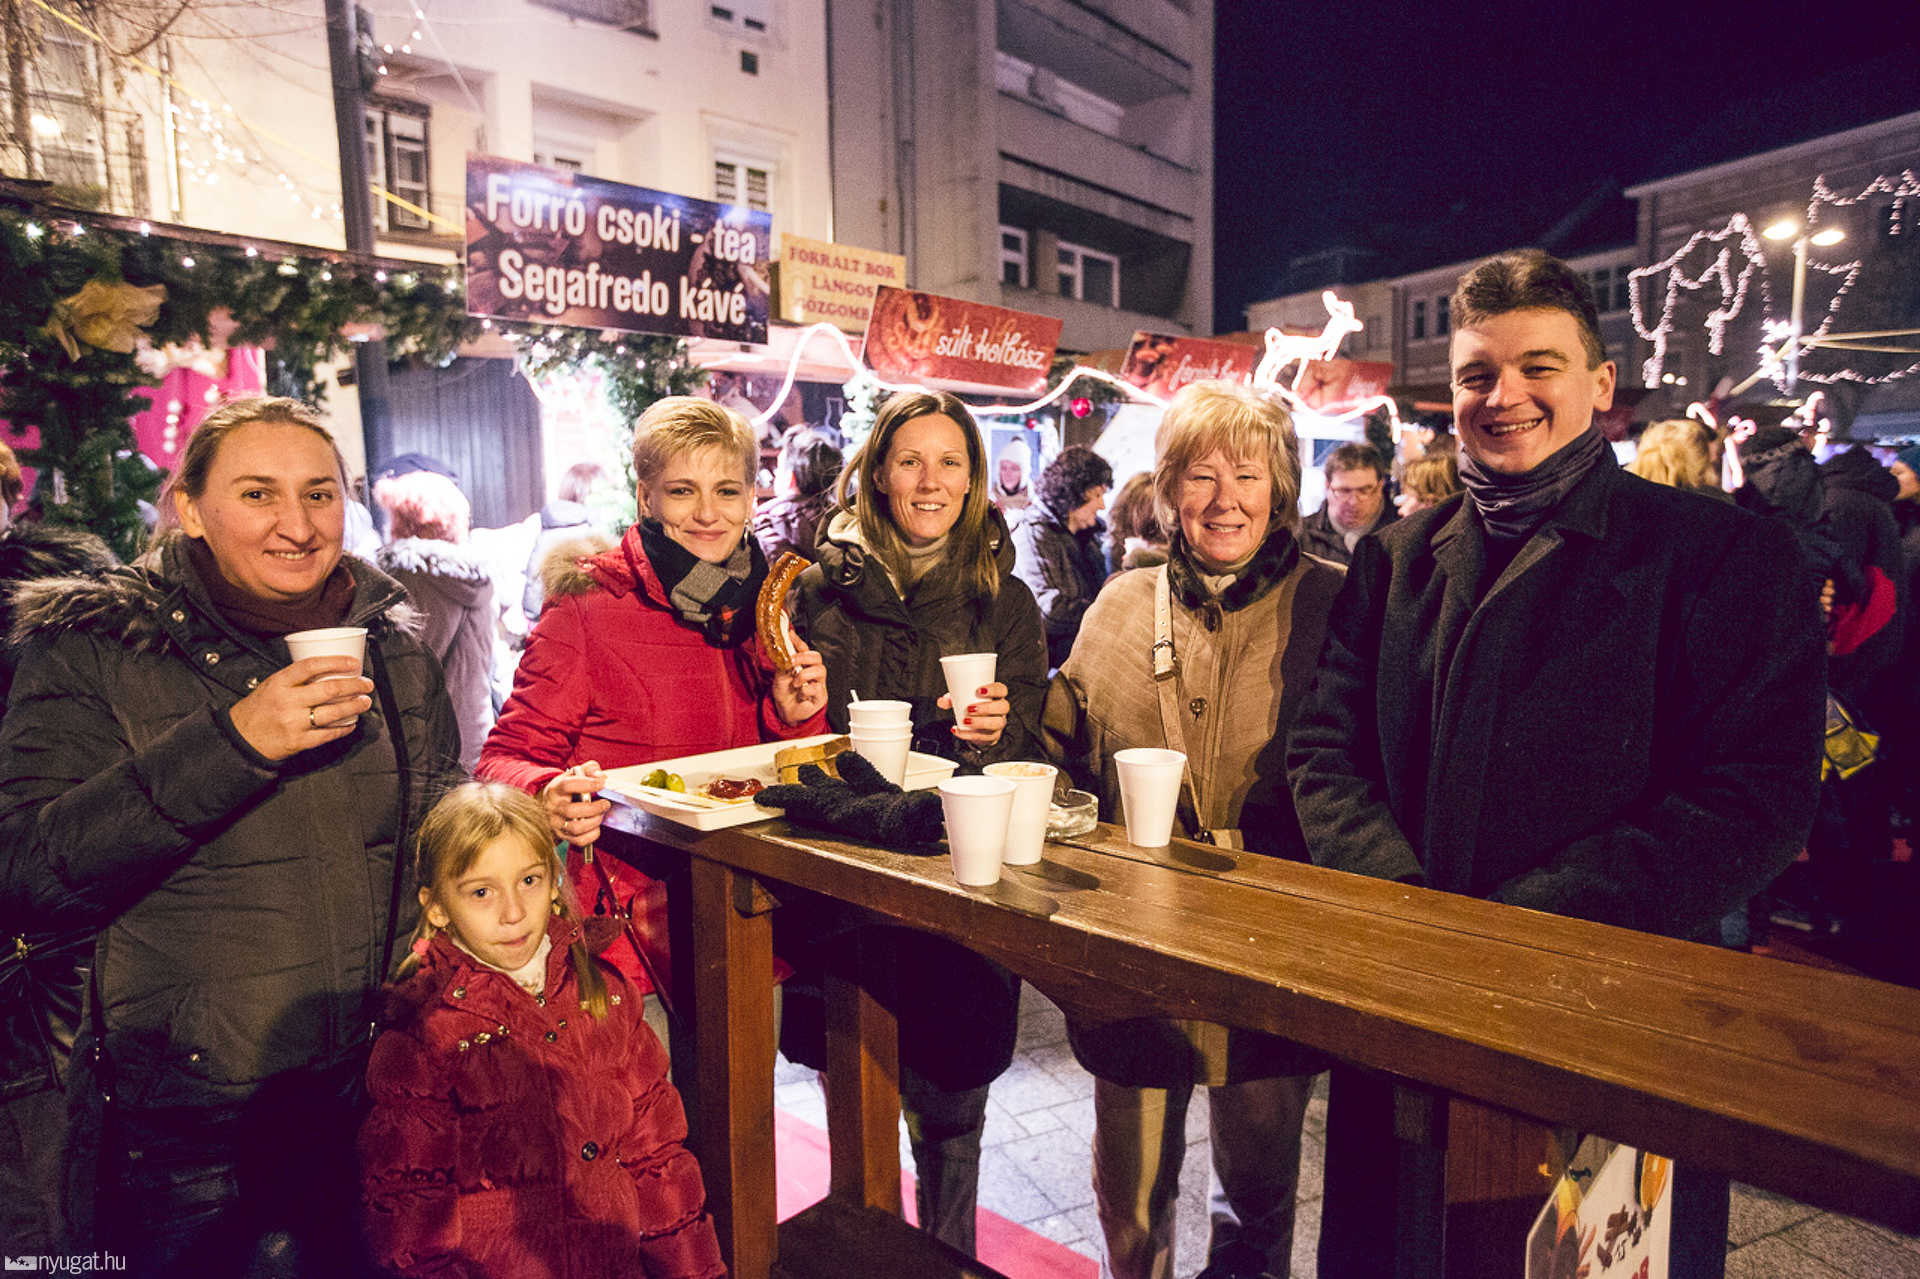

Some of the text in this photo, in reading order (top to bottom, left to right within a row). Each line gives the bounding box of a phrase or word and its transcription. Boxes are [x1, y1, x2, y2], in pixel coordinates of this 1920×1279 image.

[486, 172, 757, 265] Forró csoki - tea
[499, 249, 747, 326] Segafredo kávé
[789, 246, 896, 280] FORRALT BOR
[936, 325, 973, 359] sült
[974, 327, 1047, 371] kolbász
